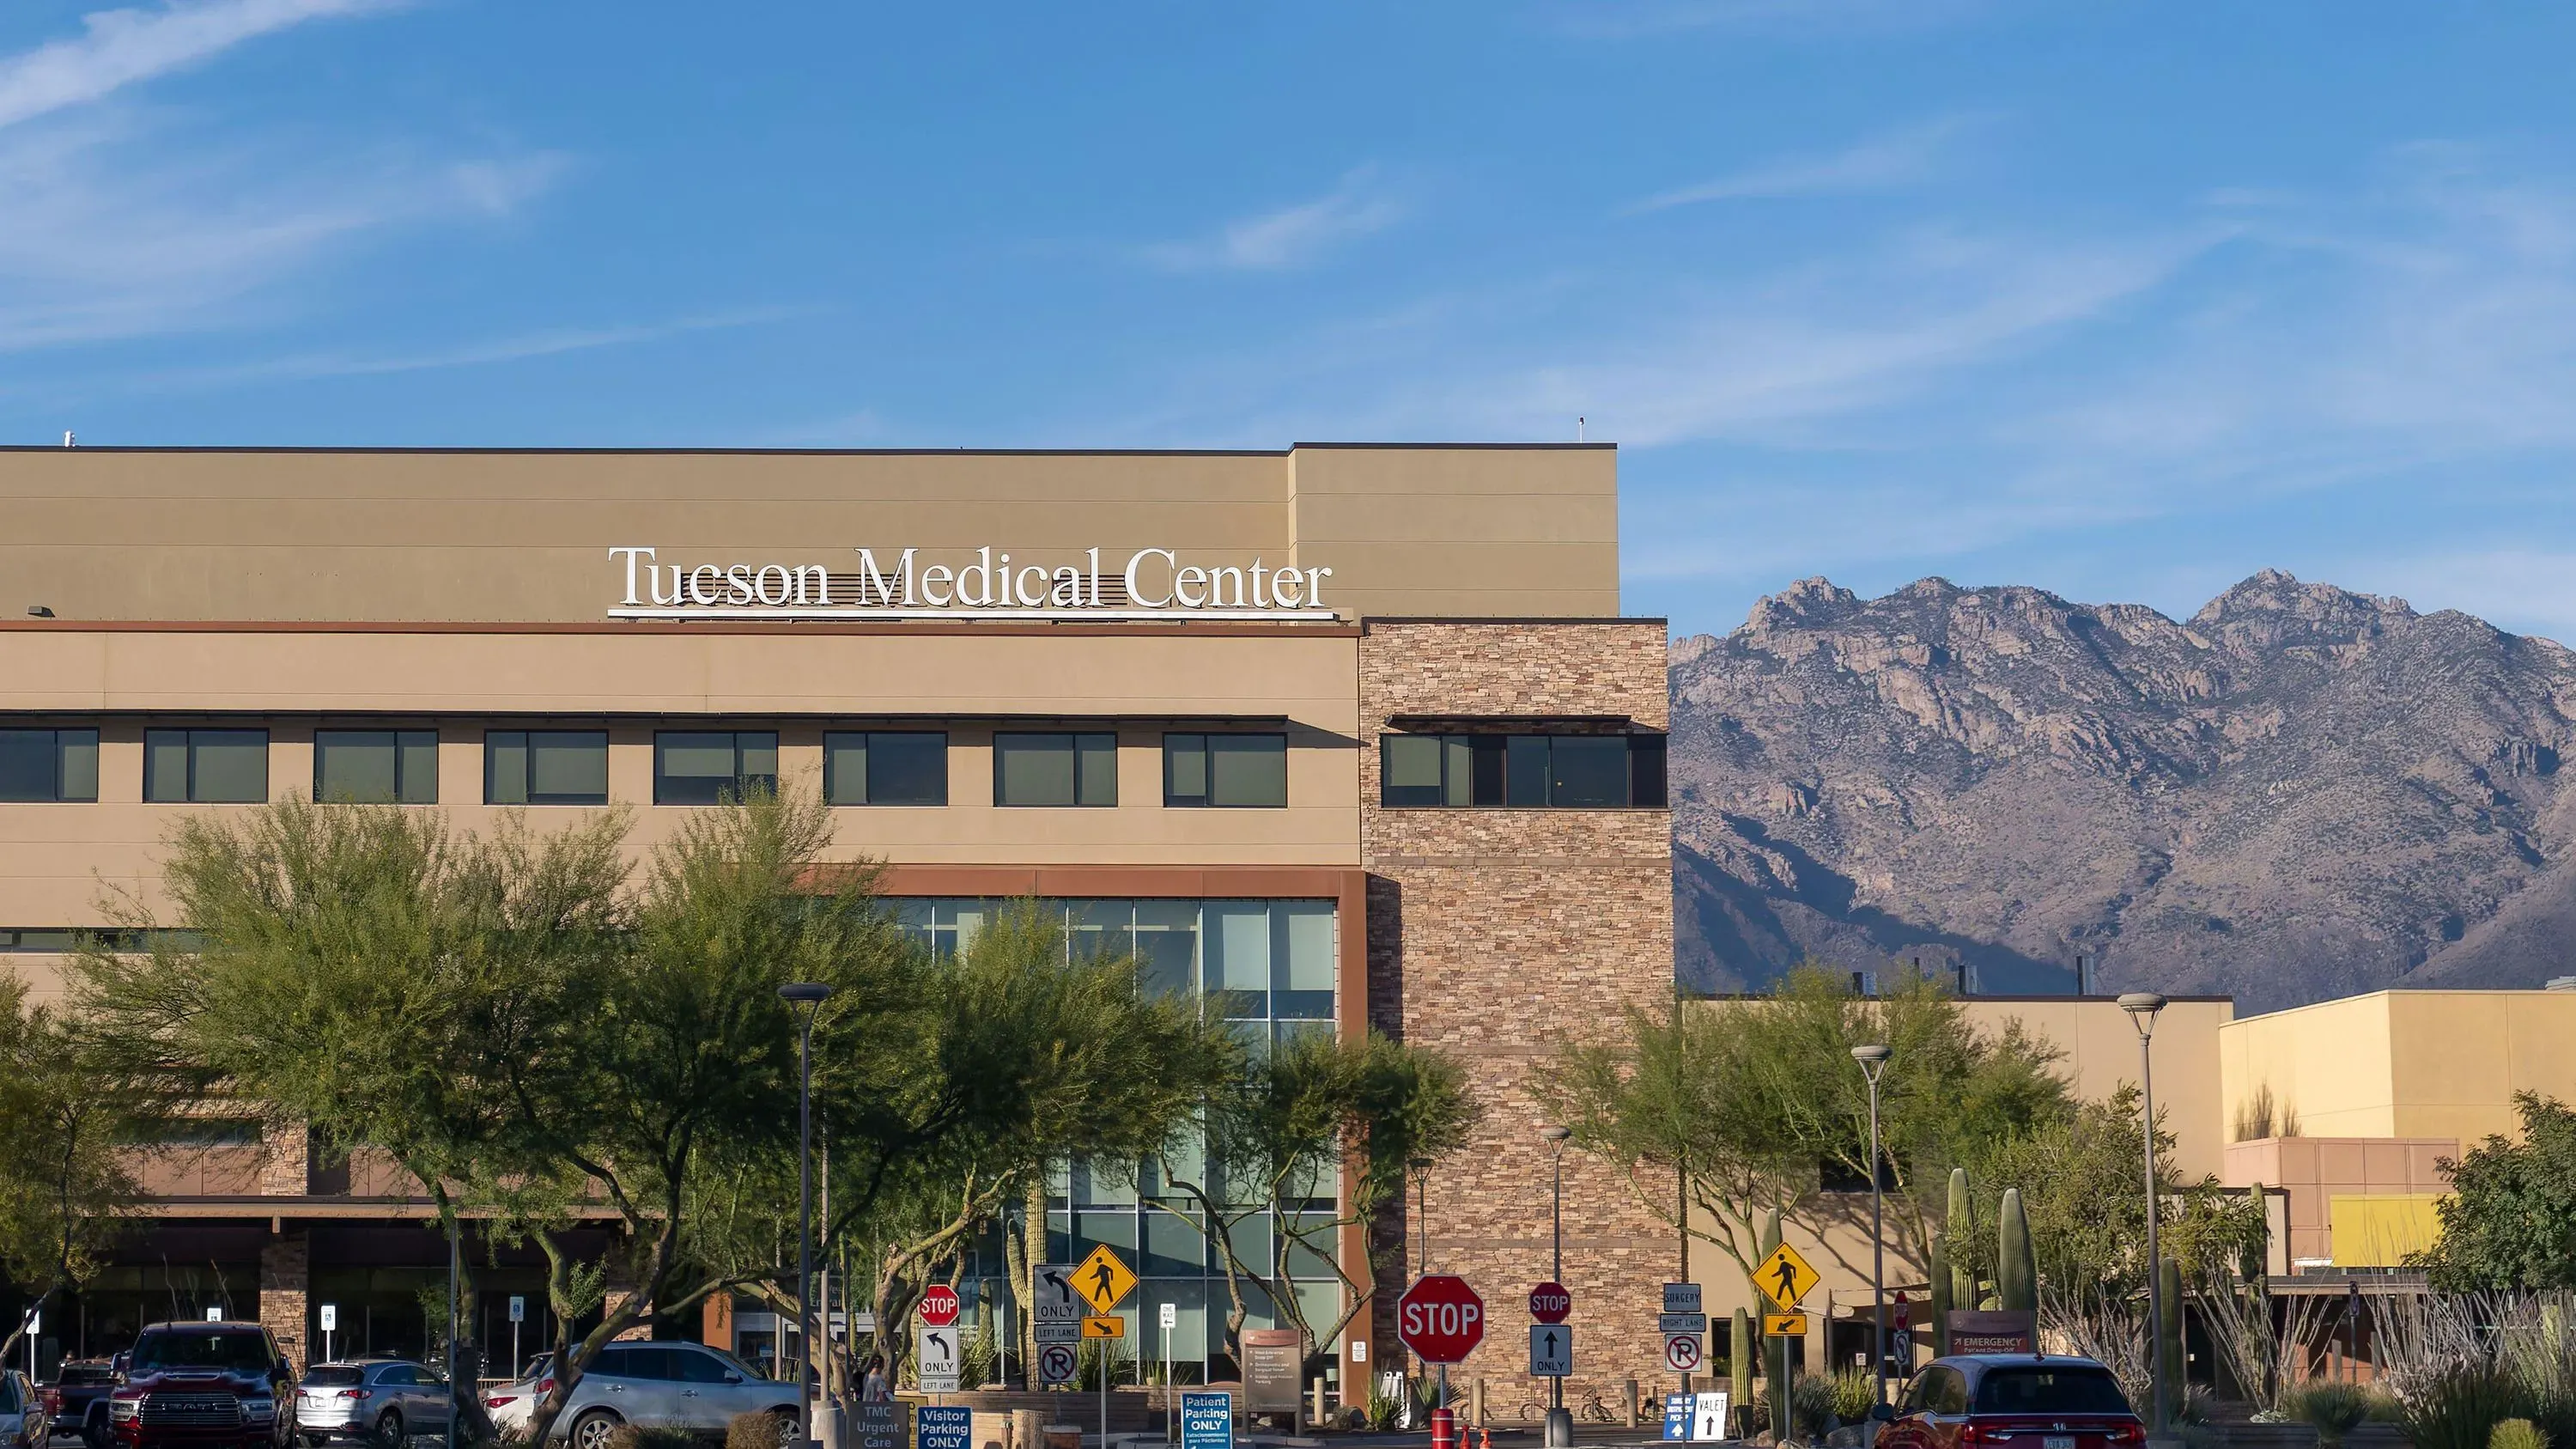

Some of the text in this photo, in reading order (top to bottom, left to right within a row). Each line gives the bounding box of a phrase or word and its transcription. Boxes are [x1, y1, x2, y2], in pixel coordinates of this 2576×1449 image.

[607, 546, 1333, 608] Tucson Medical Center
[1532, 1295, 1569, 1311] STOP
[1666, 1293, 1700, 1303] SURGERY
[921, 1298, 957, 1314] STOP
[1041, 1306, 1074, 1318] ONLY
[1405, 1303, 1479, 1336] STOP
[1662, 1318, 1683, 1327] RIGHT
[1039, 1329, 1077, 1337] LEFT LANE
[1964, 1337, 2021, 1346] EMERGENCY
[925, 1362, 954, 1373] ONLY
[1537, 1361, 1565, 1371] ONLY
[923, 1381, 937, 1390] LEFT
[1186, 1397, 1226, 1407] Patient
[1699, 1399, 1724, 1411] VALET
[865, 1407, 892, 1417] TMC
[925, 1410, 965, 1421] Visitor
[1186, 1409, 1228, 1420] Parking
[857, 1422, 900, 1434] Urgent
[920, 1424, 969, 1436] Parking
[1191, 1421, 1222, 1431] ONLY
[865, 1437, 891, 1447] Care
[927, 1437, 962, 1447] ONLY
